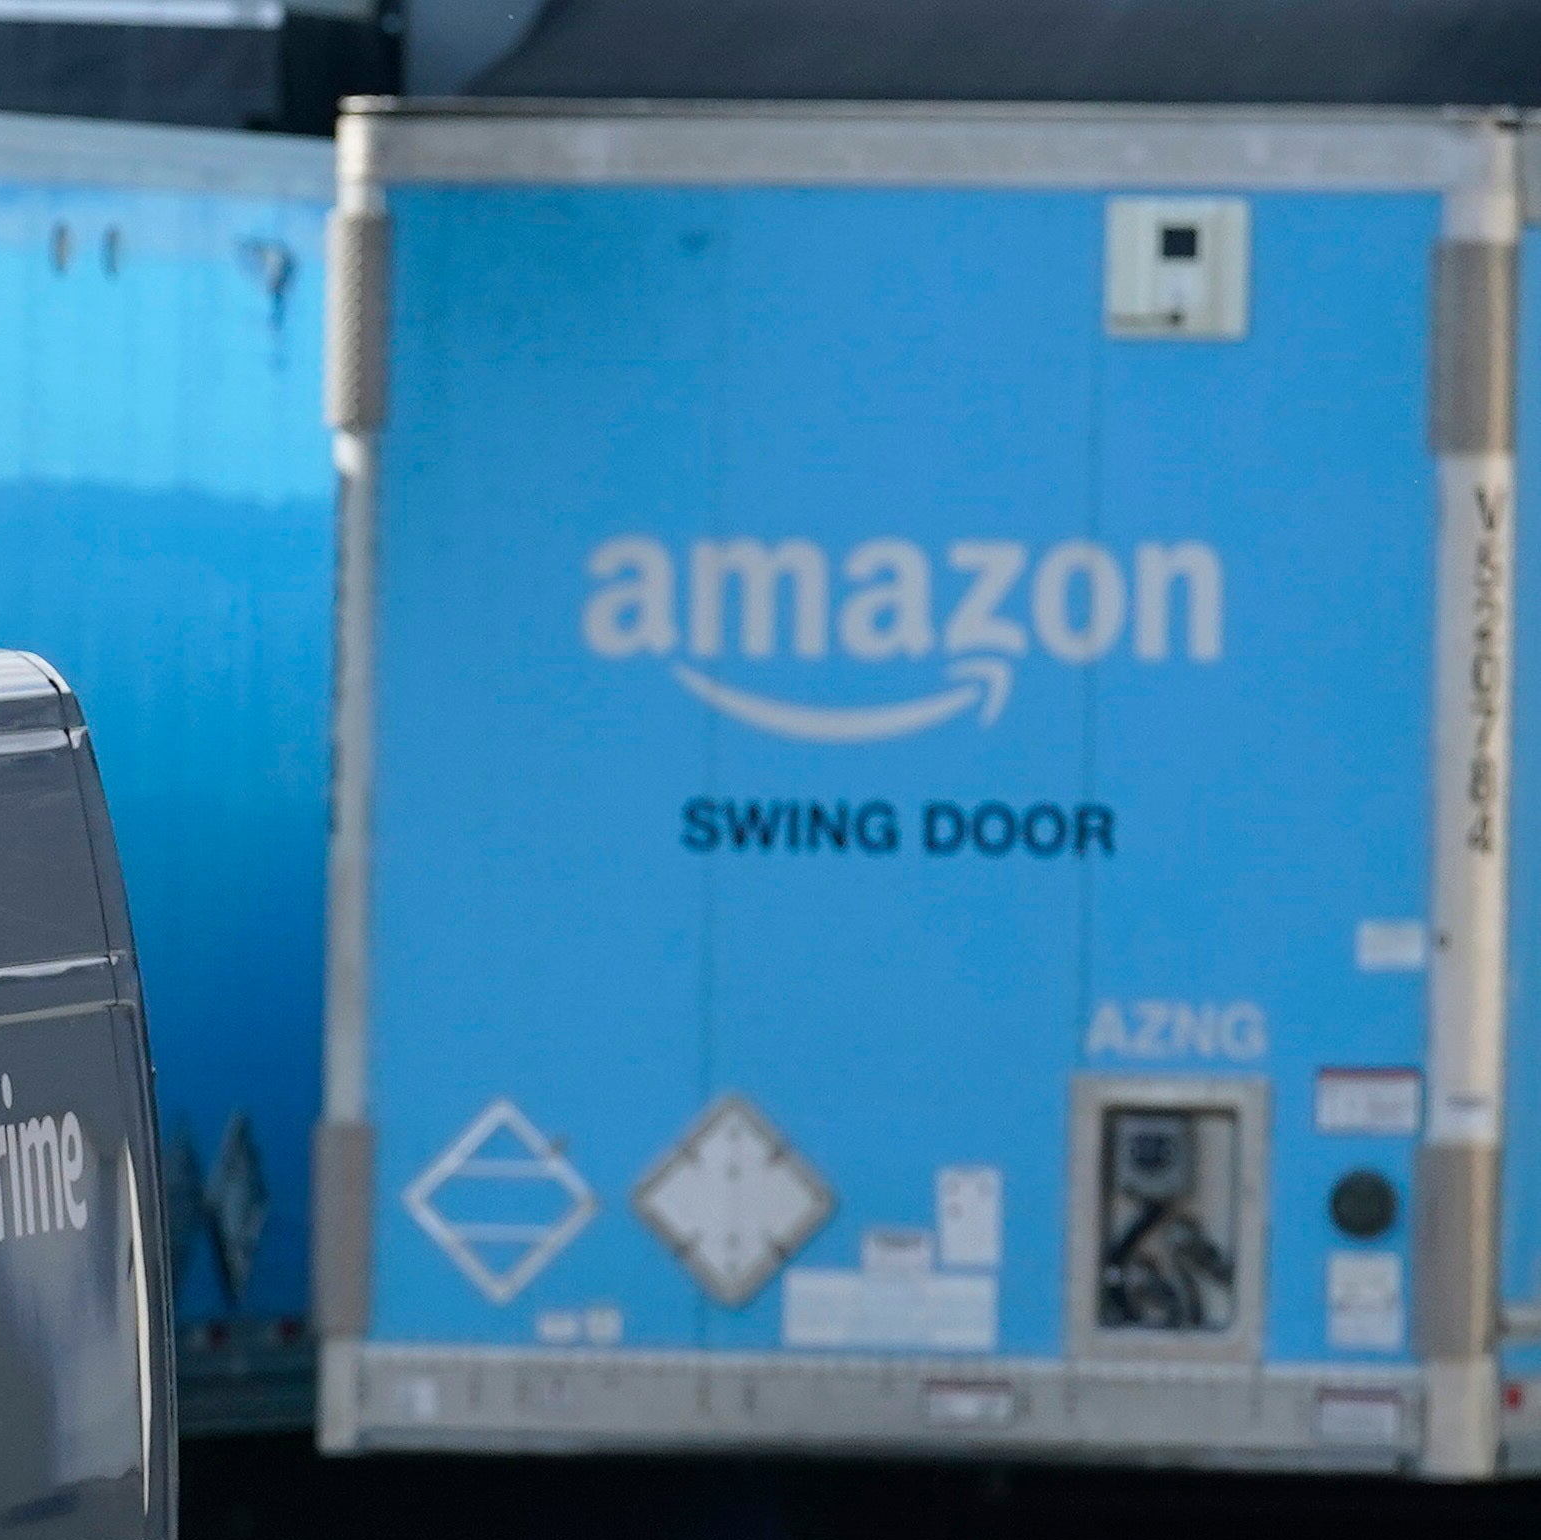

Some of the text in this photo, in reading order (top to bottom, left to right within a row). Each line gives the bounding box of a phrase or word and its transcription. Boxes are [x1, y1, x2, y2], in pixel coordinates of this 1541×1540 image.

[582, 535, 1224, 663] amazon
[680, 797, 1117, 857] SWING DOOR
[1088, 1000, 1269, 1060] AZNG
